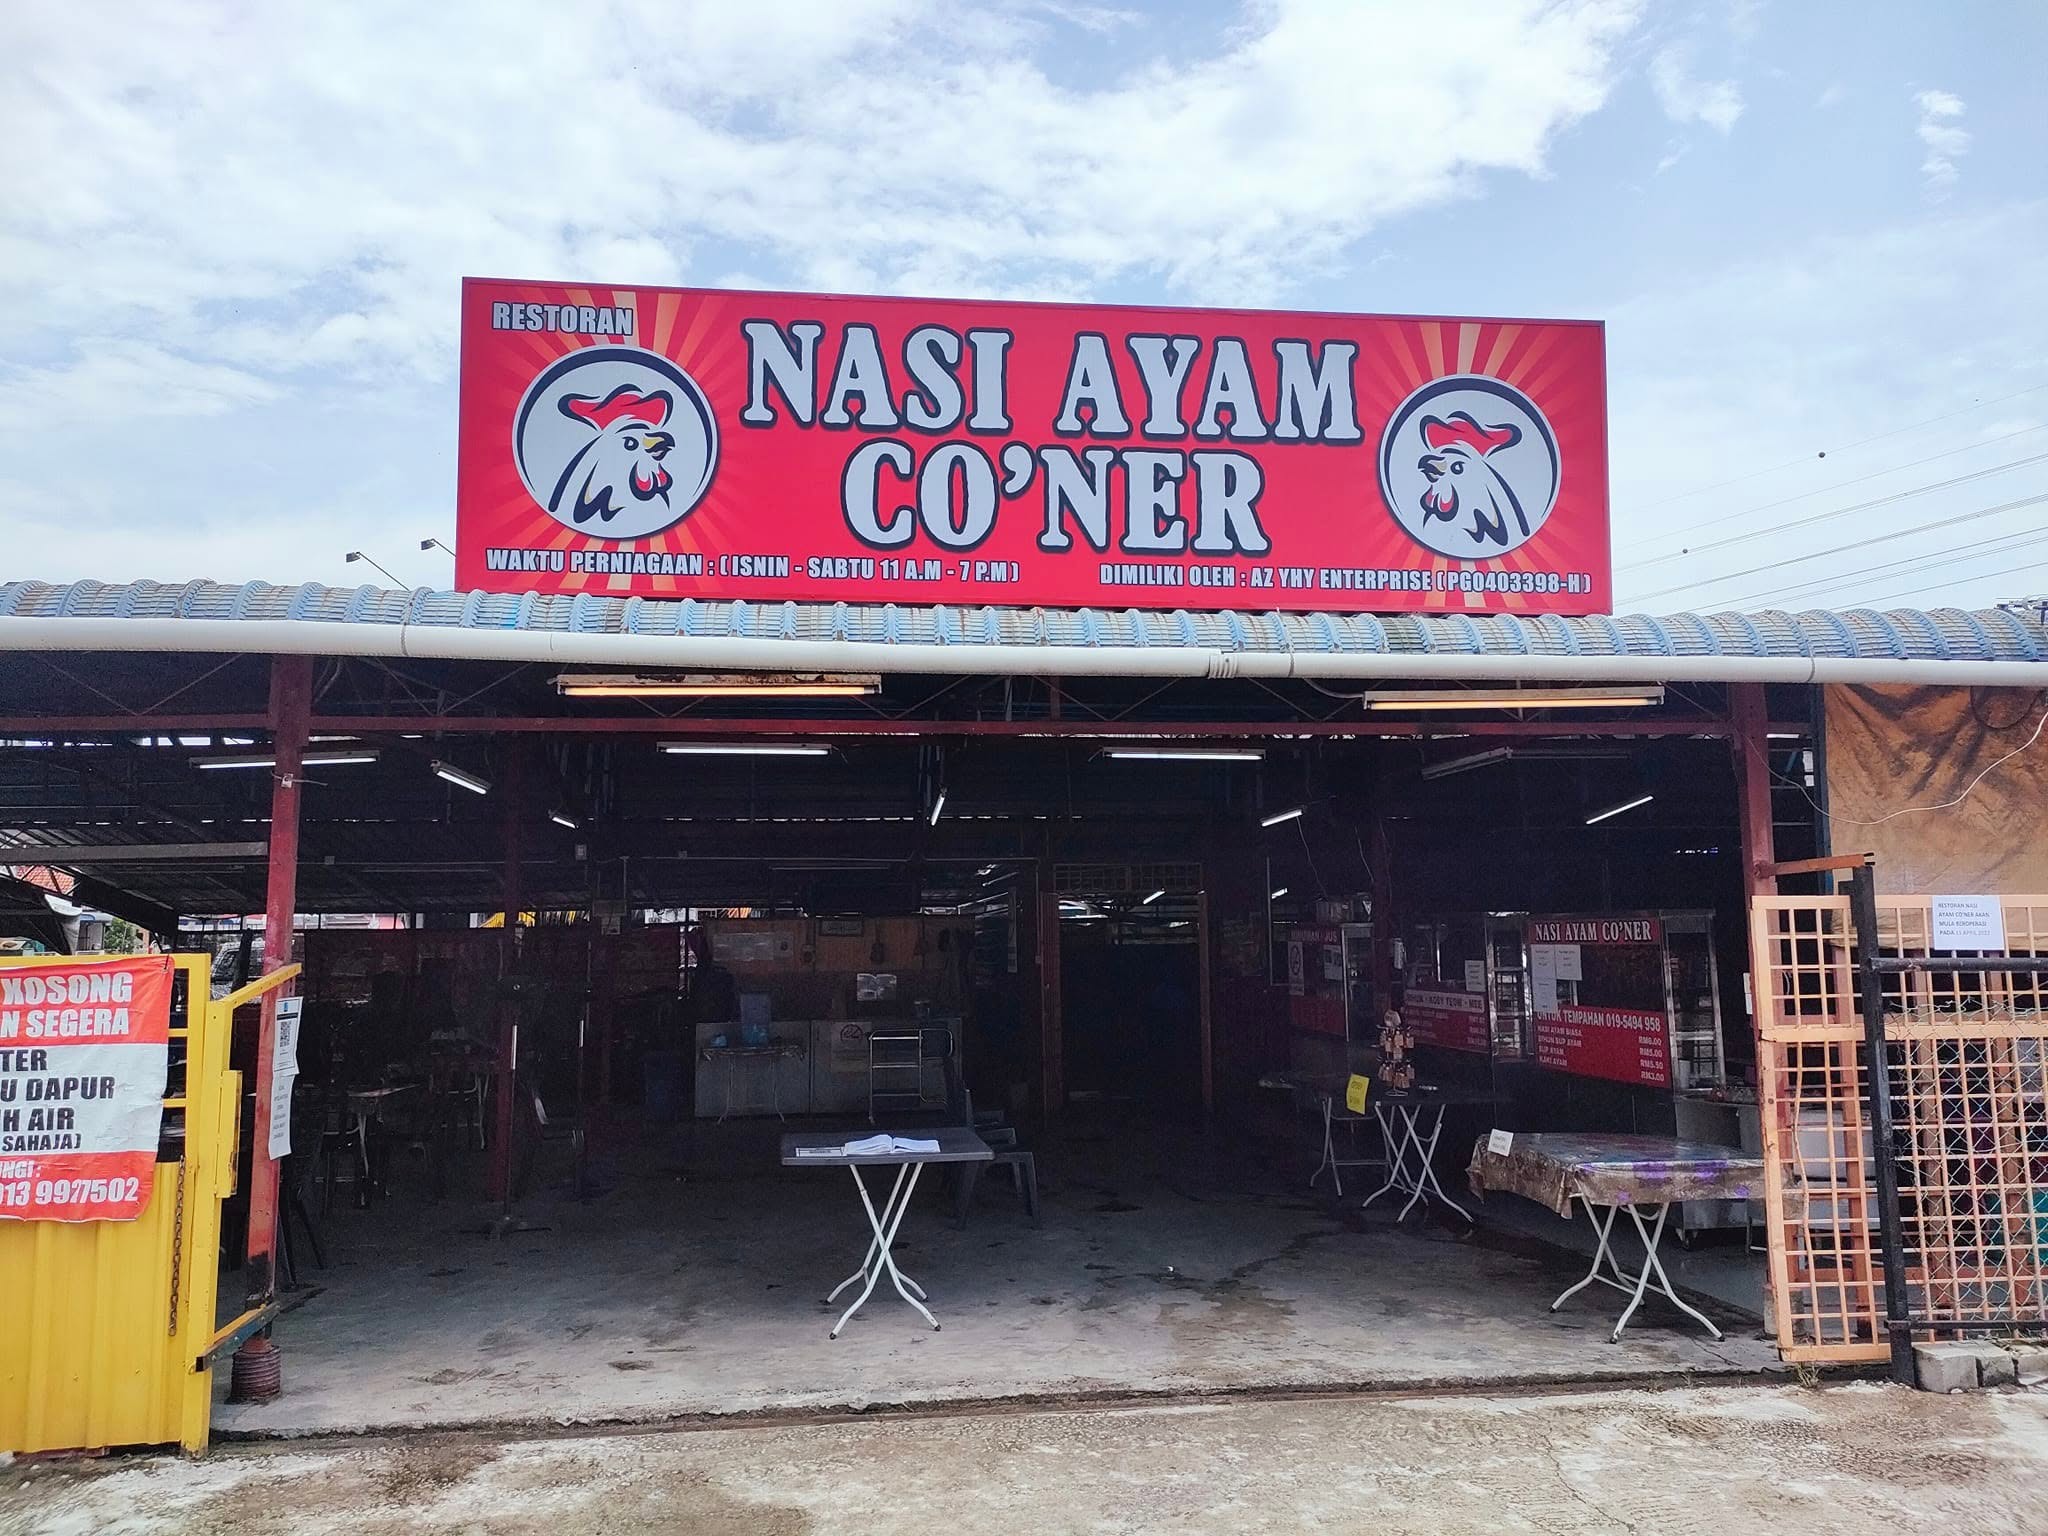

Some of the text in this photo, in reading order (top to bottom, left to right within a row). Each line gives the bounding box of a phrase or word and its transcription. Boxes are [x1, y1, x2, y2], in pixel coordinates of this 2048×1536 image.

[493, 302, 632, 334] RESTORAN
[742, 321, 1364, 443] NASI AYAM
[845, 440, 1271, 556] CO'NER
[486, 549, 564, 572] WAKTU
[570, 550, 702, 575] PERNIAGAAN
[807, 556, 874, 579] SABTU
[879, 559, 899, 579] 11
[904, 560, 942, 581] A.M
[959, 561, 969, 581] 7
[1100, 564, 1184, 586] DIMILIKI
[1189, 566, 1235, 587] OLEH
[1250, 567, 1274, 588] AZ
[1278, 568, 1314, 589] YHY
[1319, 569, 1431, 591] ENTERPRISE
[1535, 920, 1652, 941] NASI AYAM CO'NER
[0, 972, 132, 1005] KOSONG
[25, 1007, 129, 1037] SEGERA
[1563, 1009, 1605, 1026] TEMPAHAN
[1644, 1016, 1661, 1032] 958
[26, 1076, 115, 1101] DAPUR
[28, 1107, 75, 1131] AIR
[2, 1133, 82, 1152] SAHAJA)
